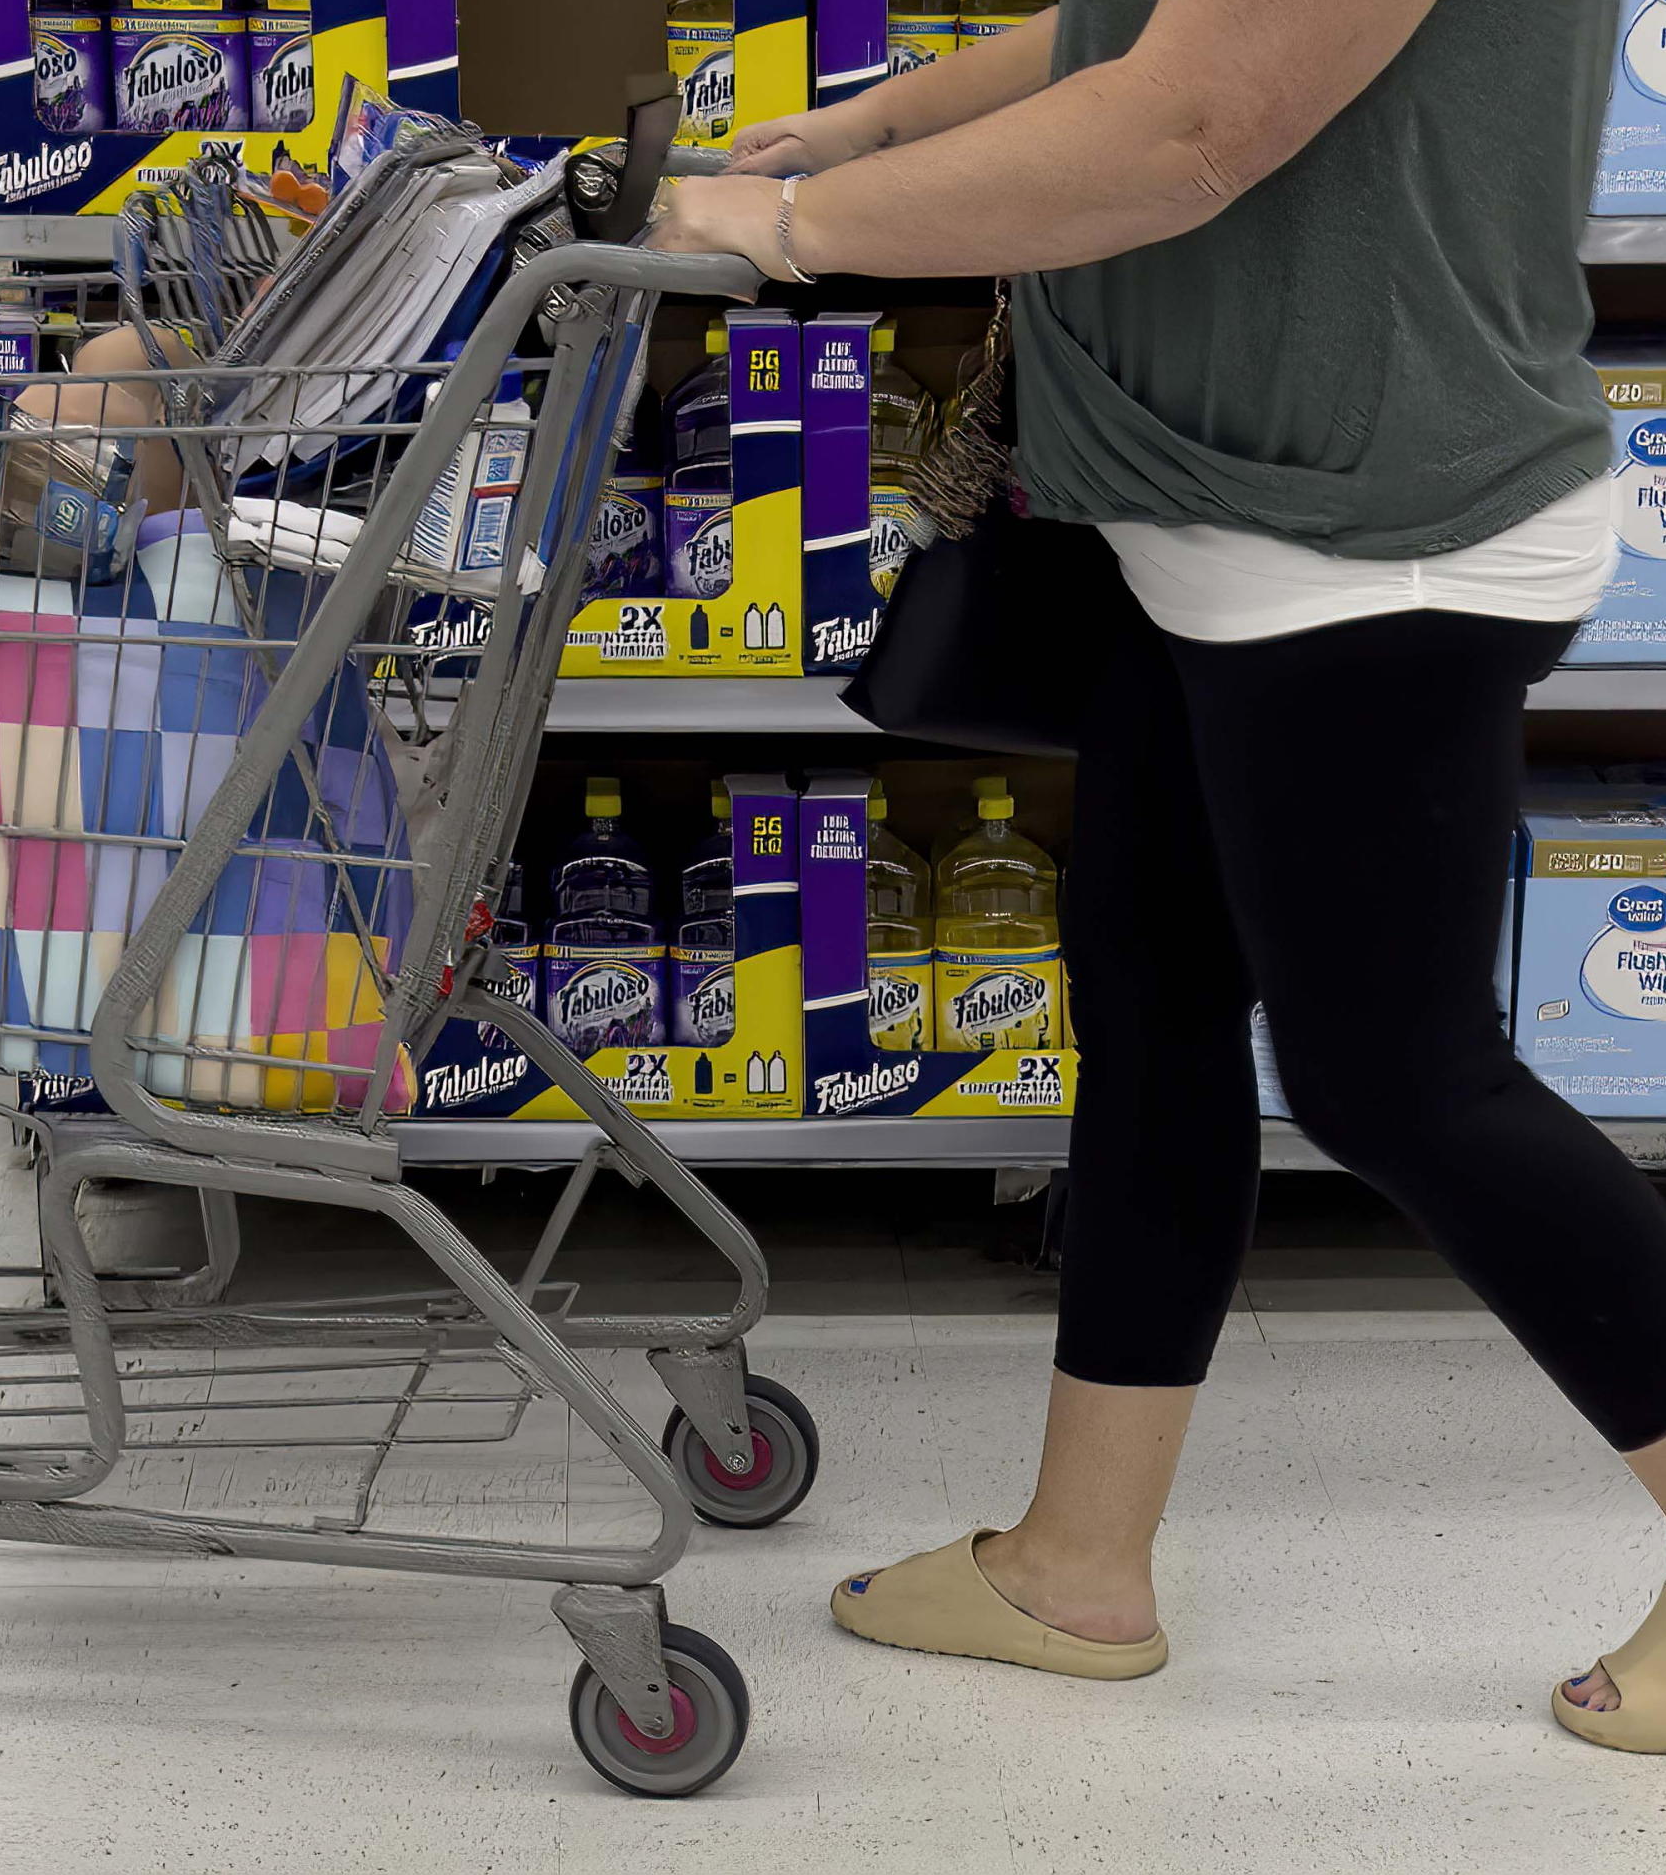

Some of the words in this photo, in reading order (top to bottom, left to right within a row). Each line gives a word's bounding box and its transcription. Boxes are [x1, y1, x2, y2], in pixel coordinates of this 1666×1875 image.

[125, 51, 223, 104] Fabuloso
[749, 349, 780, 371] 56
[618, 604, 664, 632] 2X
[812, 607, 883, 663] Fabul
[752, 816, 782, 836] 56
[558, 971, 650, 1025] Fabuloso
[952, 974, 1046, 1025] Fabuloso
[624, 1053, 668, 1078] 2X
[814, 1057, 921, 1113] Fabuloso
[1016, 1055, 1061, 1081] 2X
